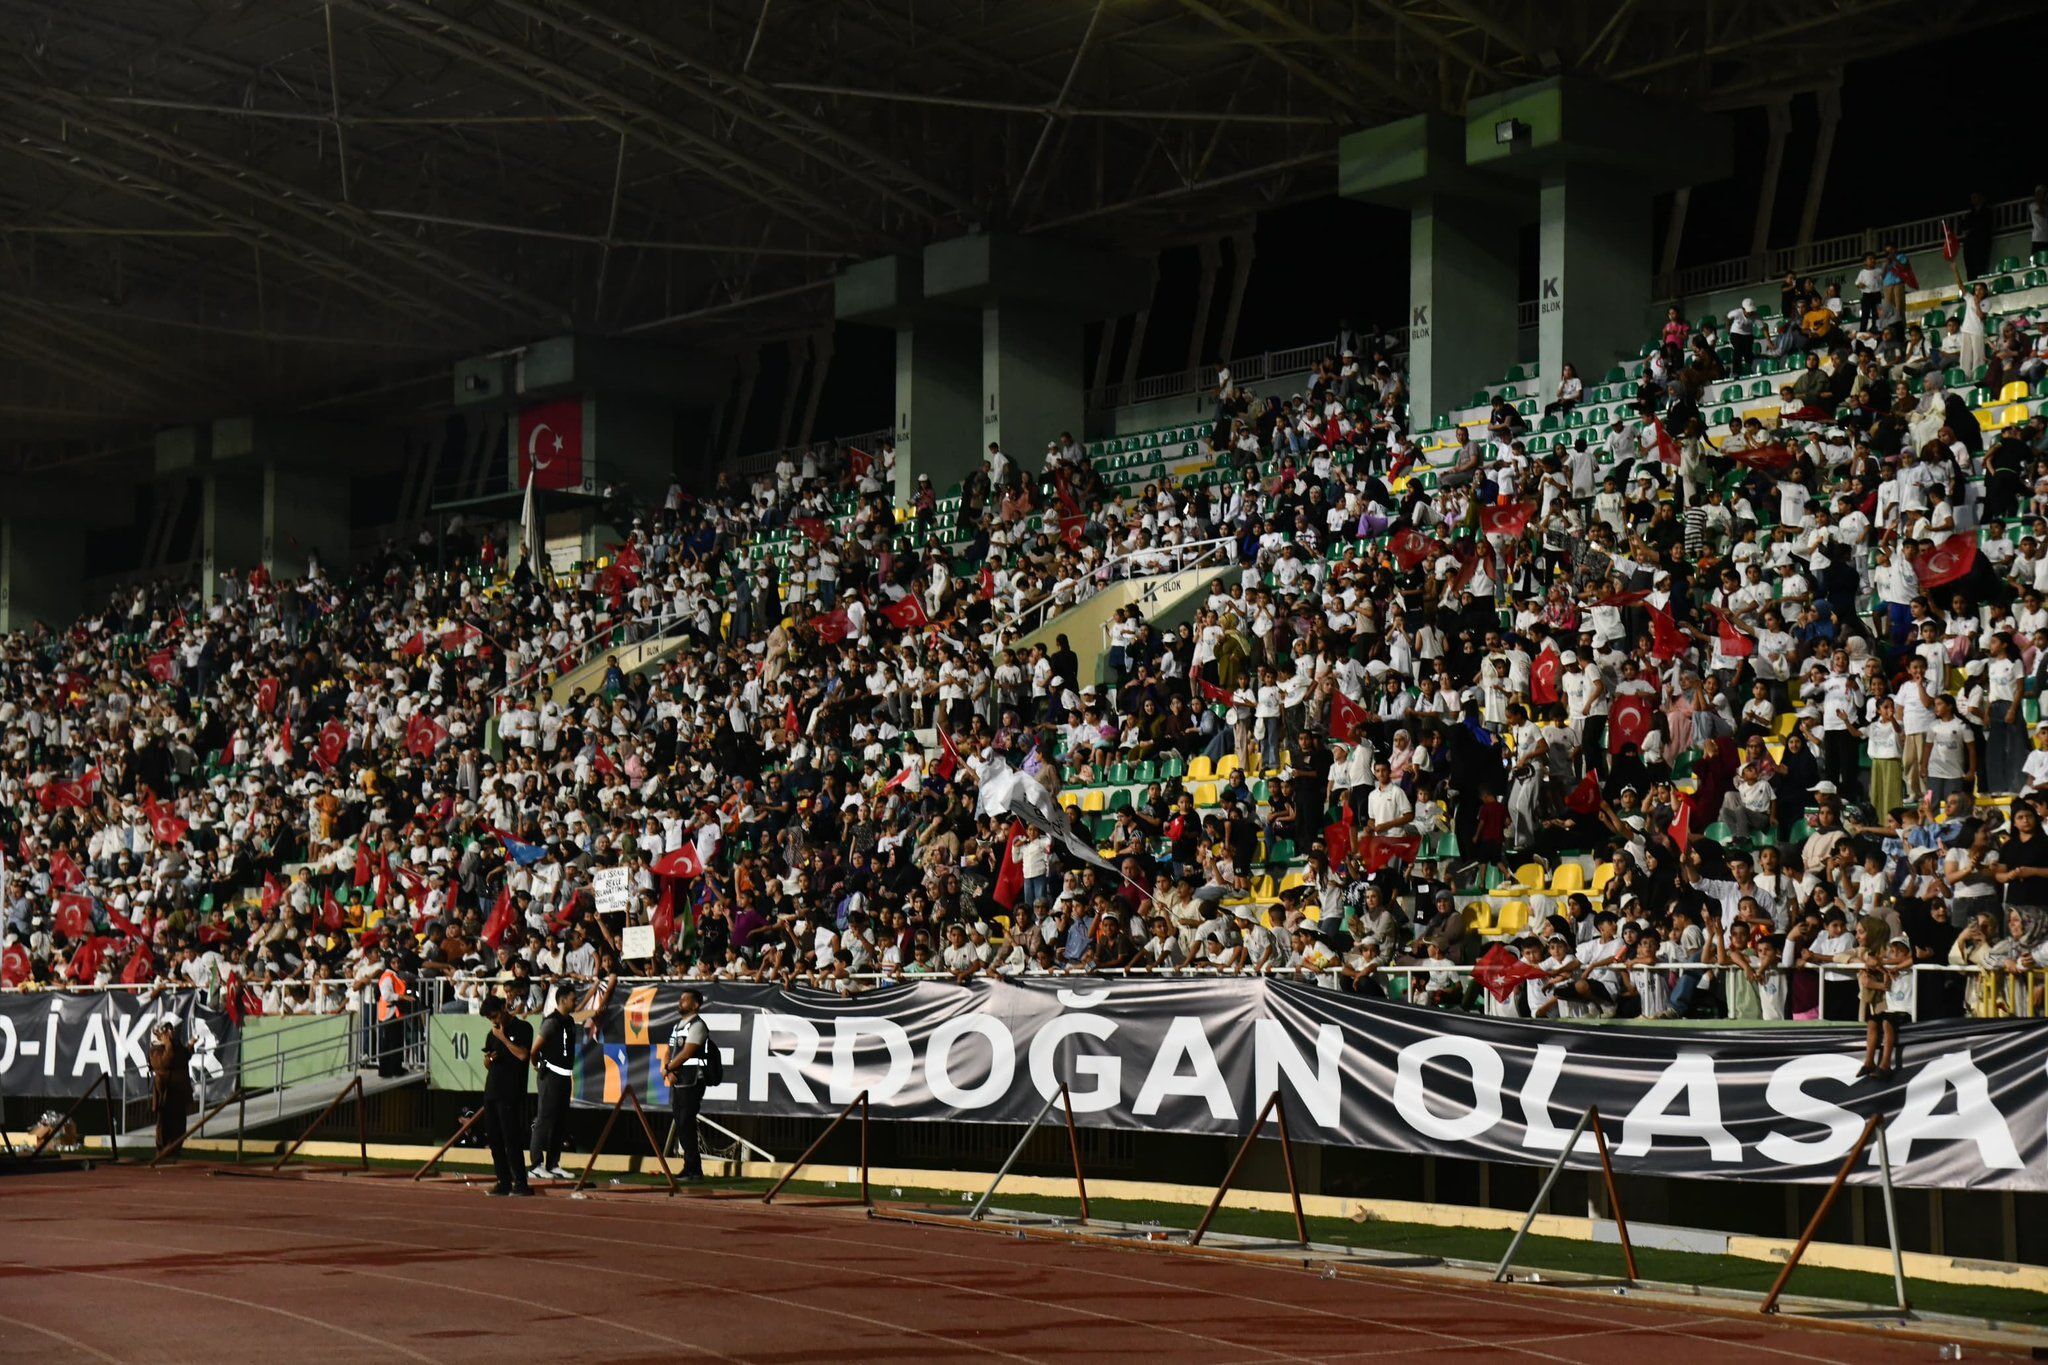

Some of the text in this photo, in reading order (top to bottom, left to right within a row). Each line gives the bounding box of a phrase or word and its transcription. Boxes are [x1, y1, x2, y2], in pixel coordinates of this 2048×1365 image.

[1543, 277, 1559, 299] K
[1413, 305, 1428, 326] K
[1542, 301, 1561, 313] BLOK
[1412, 327, 1430, 339] BLOK
[1143, 580, 1181, 603] K BLOK
[451, 1031, 469, 1061] 10
[699, 988, 2048, 1171] ERDOĞAN OLASA
